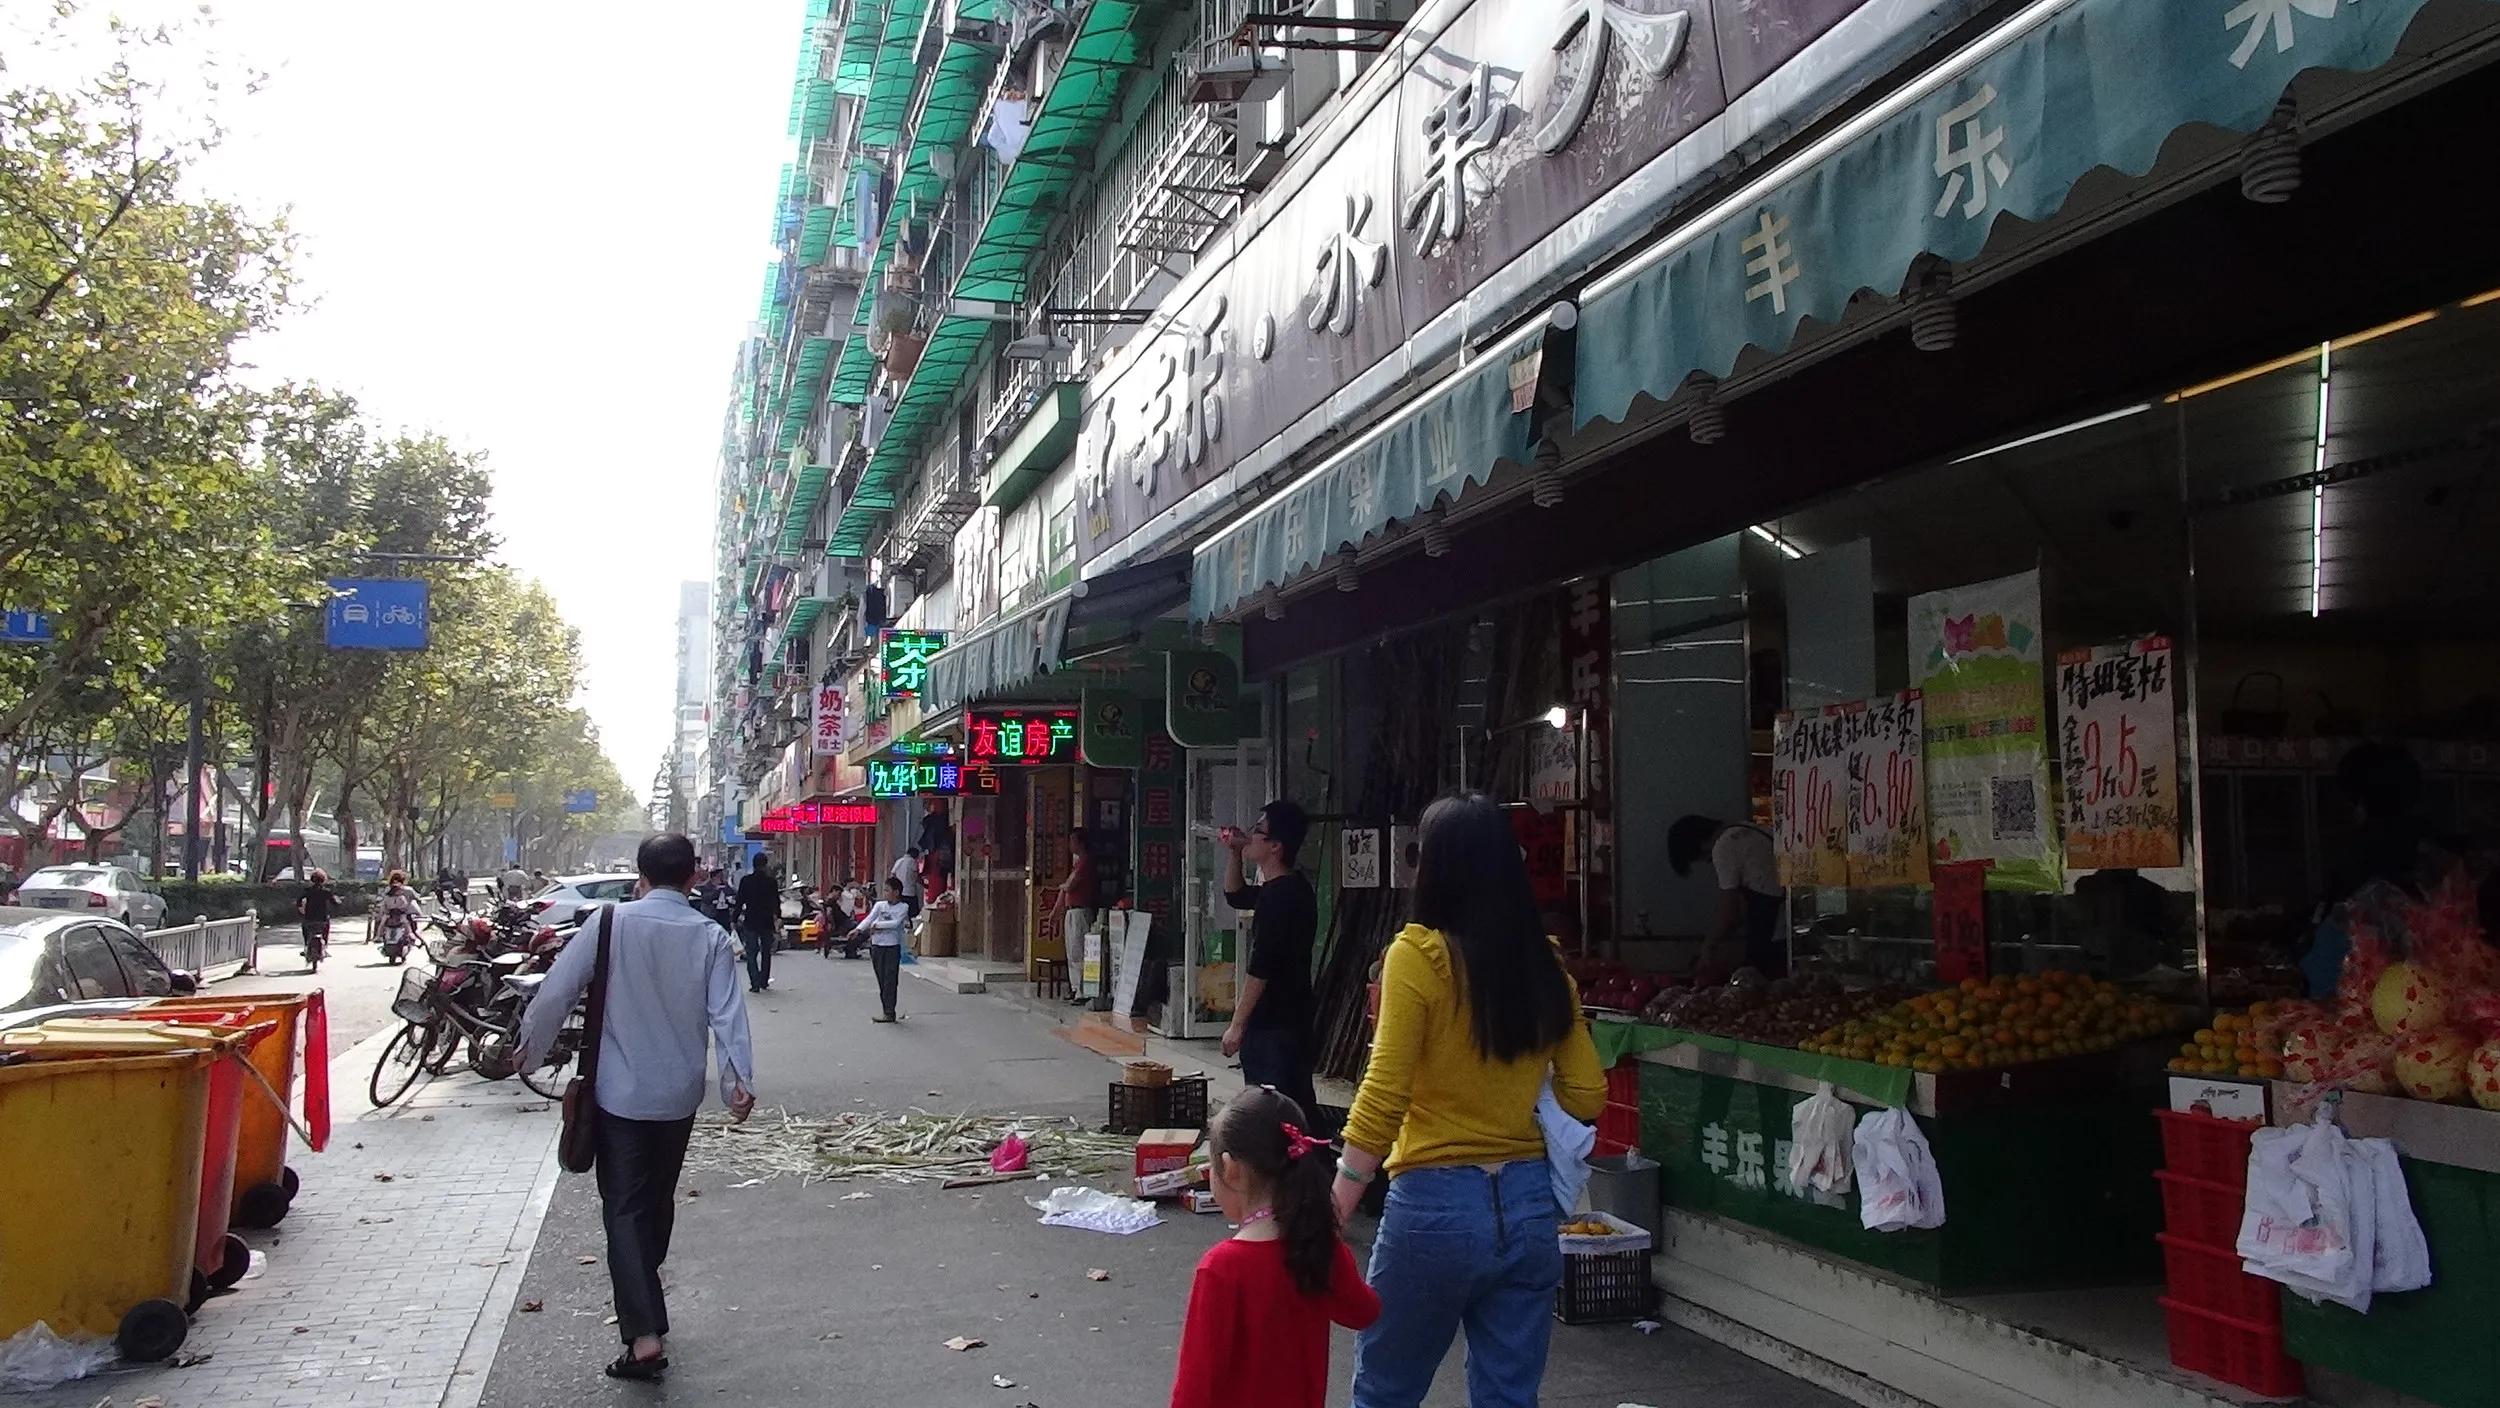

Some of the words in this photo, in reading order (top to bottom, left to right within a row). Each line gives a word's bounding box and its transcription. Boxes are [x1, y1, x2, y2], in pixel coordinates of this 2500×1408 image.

[889, 637, 939, 689] 茶
[818, 690, 842, 737] 奶茶
[972, 719, 1074, 757] 友谊房产
[1143, 731, 1174, 934] 房屋租赁
